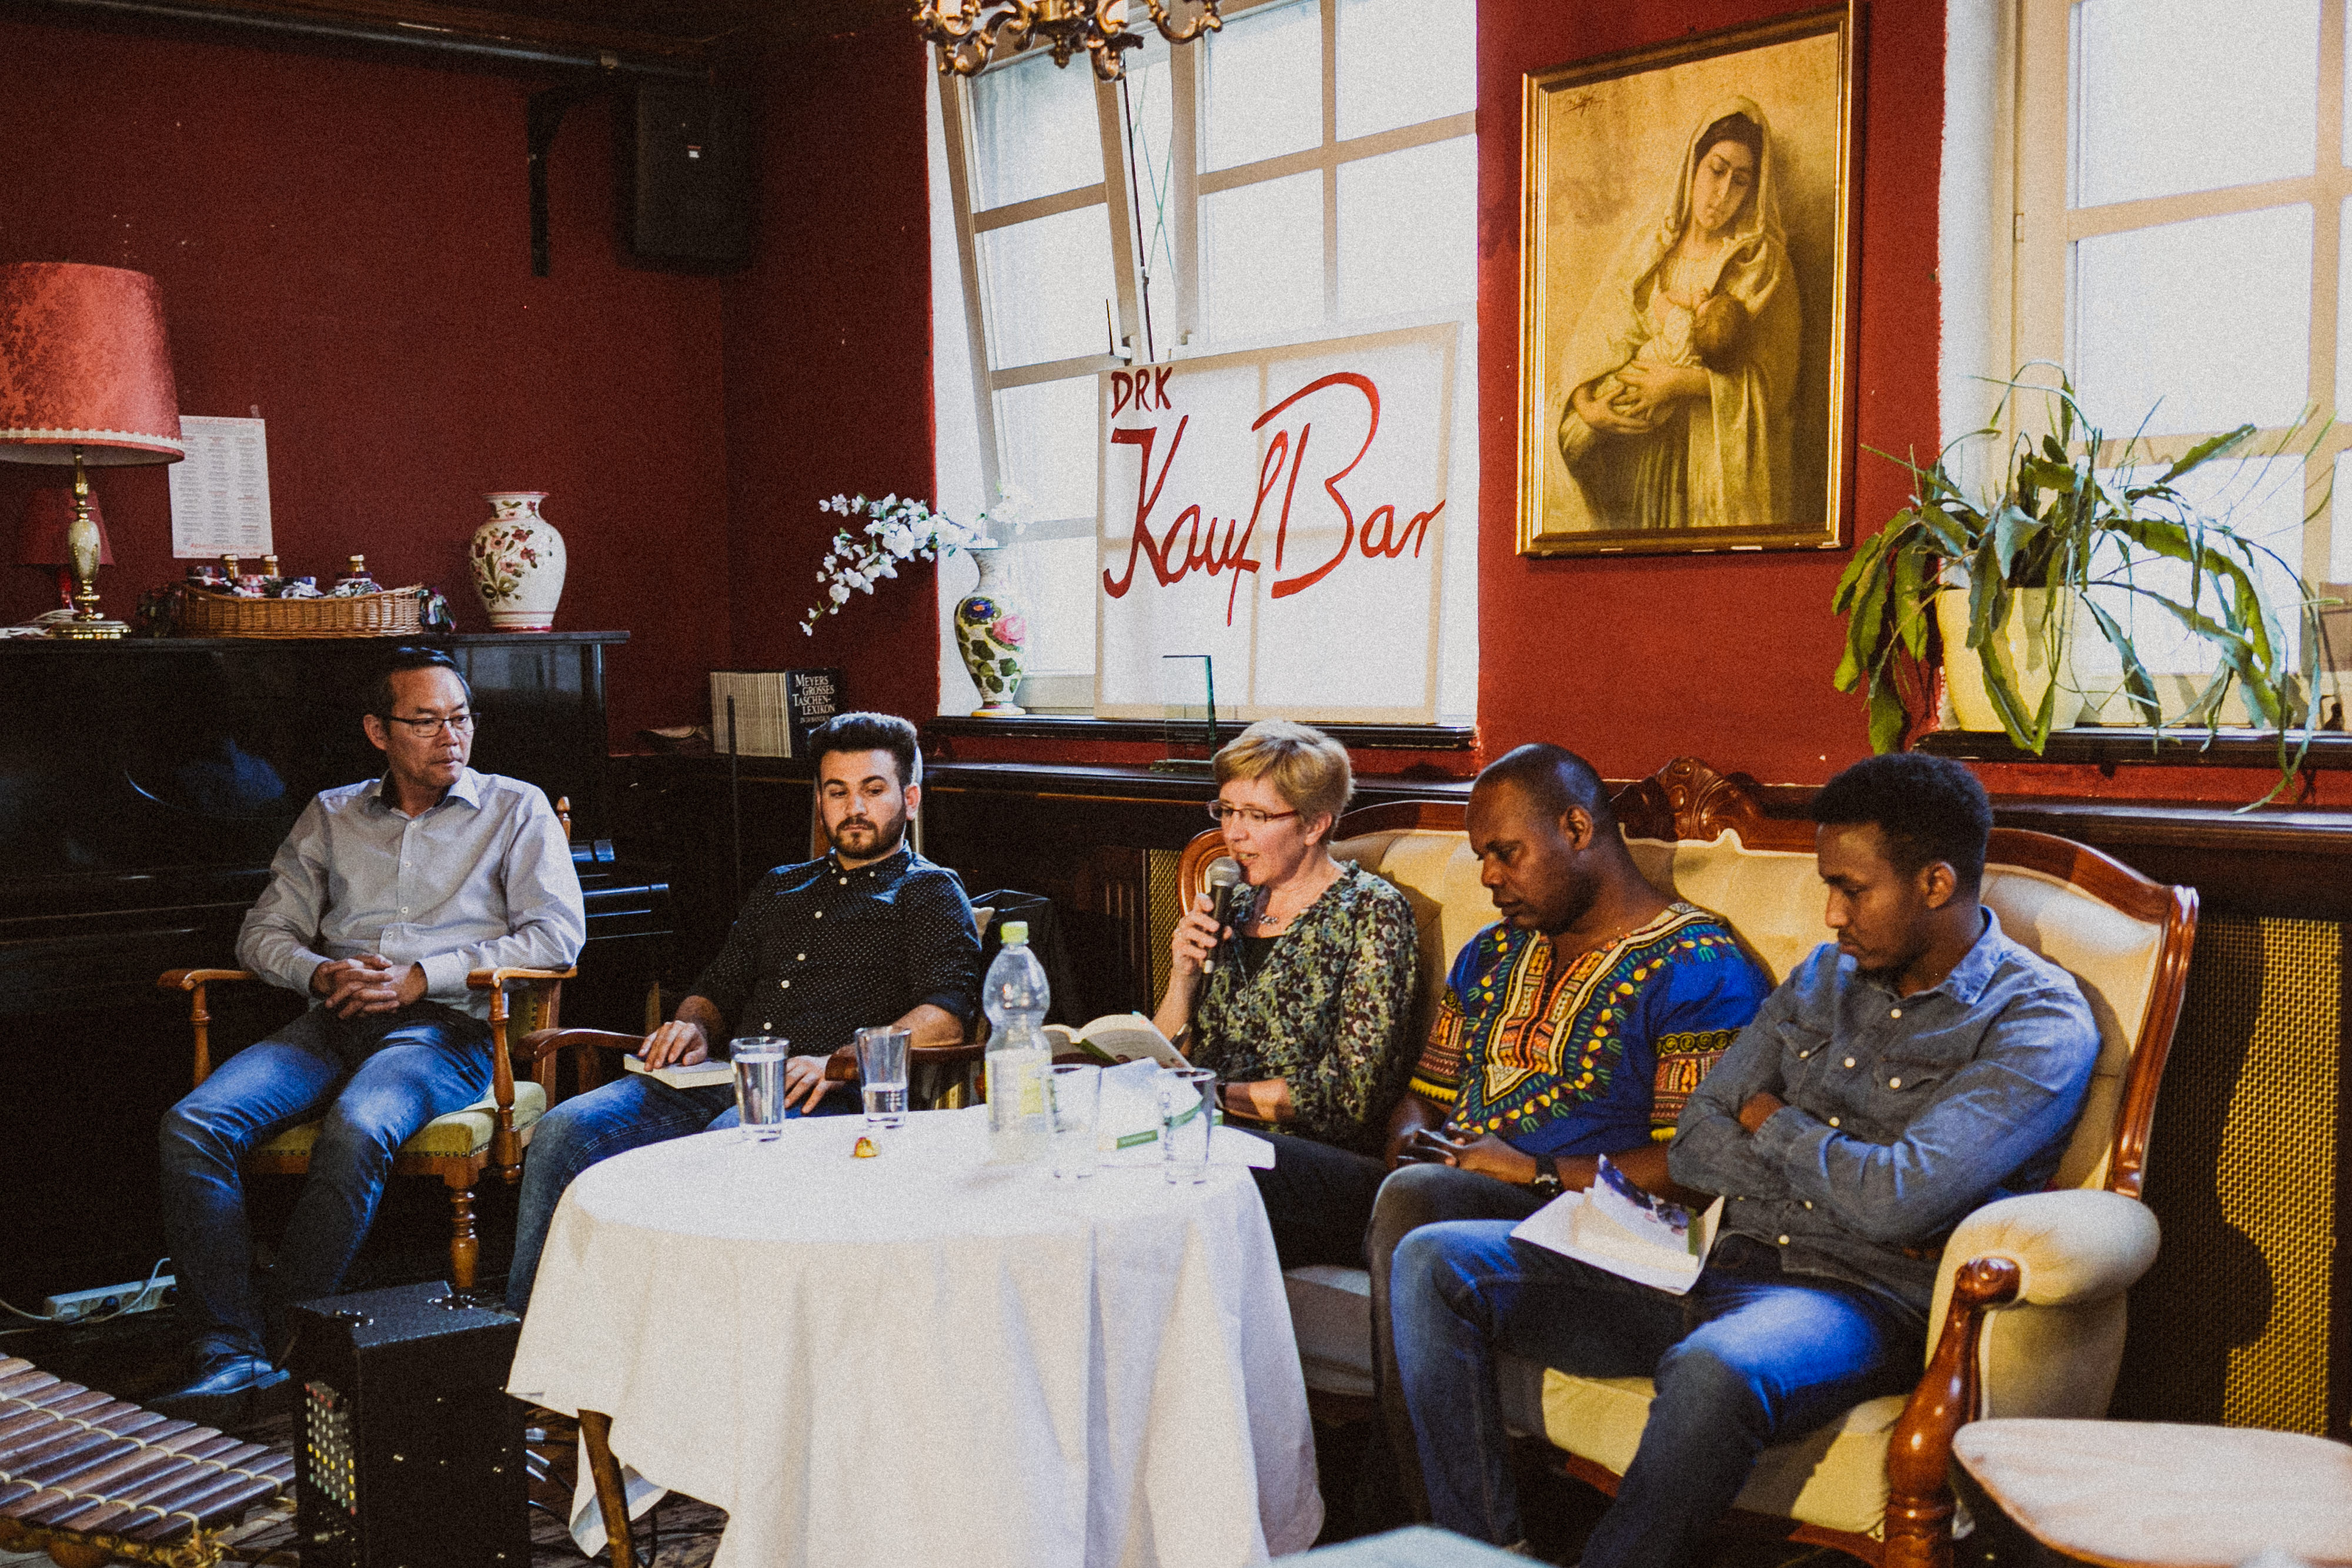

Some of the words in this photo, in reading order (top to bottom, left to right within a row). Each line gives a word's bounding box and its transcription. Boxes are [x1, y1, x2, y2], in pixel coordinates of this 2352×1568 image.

[1111, 366, 1172, 418] DRK
[795, 674, 828, 687] MEYERS
[802, 685, 835, 696] GROSSES
[791, 694, 831, 707] TASCHEN-
[802, 704, 835, 716] LEXIKON
